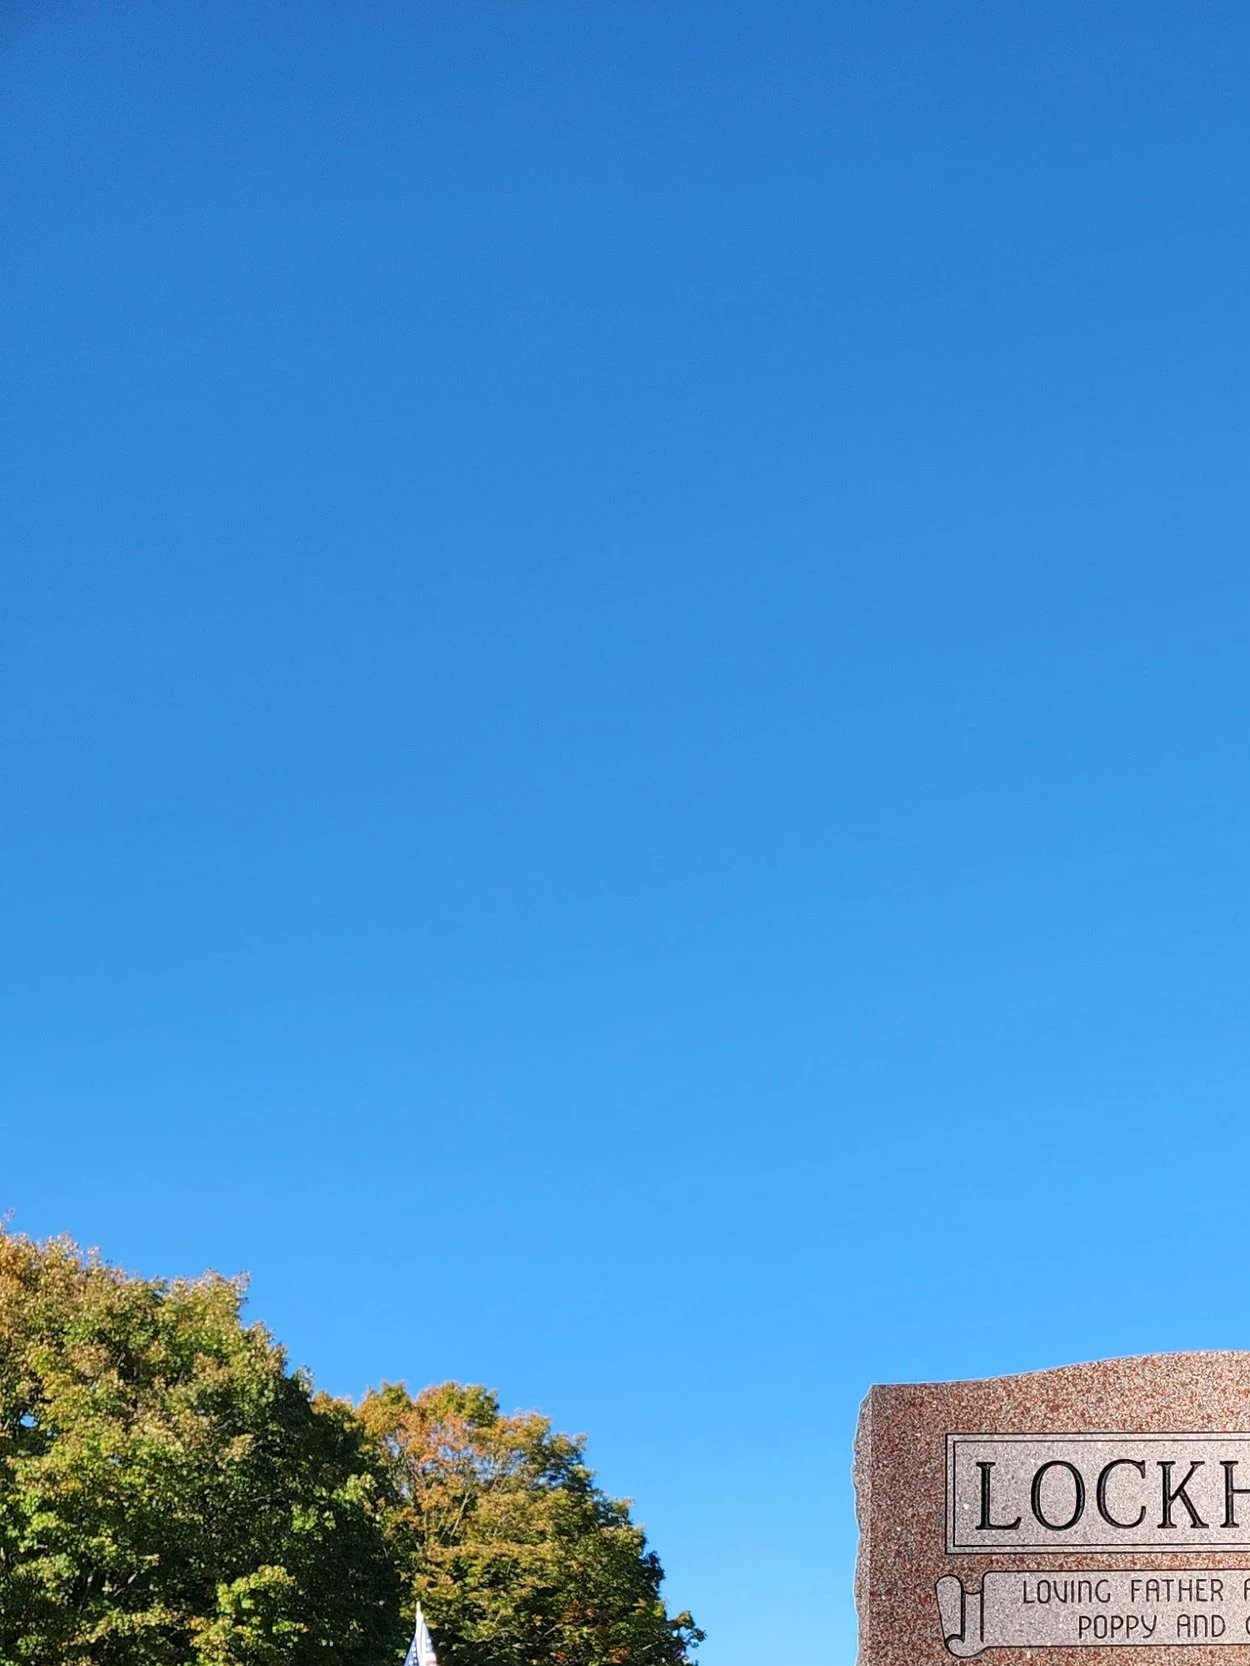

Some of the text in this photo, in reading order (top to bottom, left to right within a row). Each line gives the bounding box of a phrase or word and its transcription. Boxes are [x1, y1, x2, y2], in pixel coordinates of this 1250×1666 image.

[1022, 1578, 1111, 1604] LOVING
[1131, 1577, 1224, 1603] FATHER
[1078, 1614, 1157, 1639] POPPY
[1177, 1614, 1226, 1638] AND
